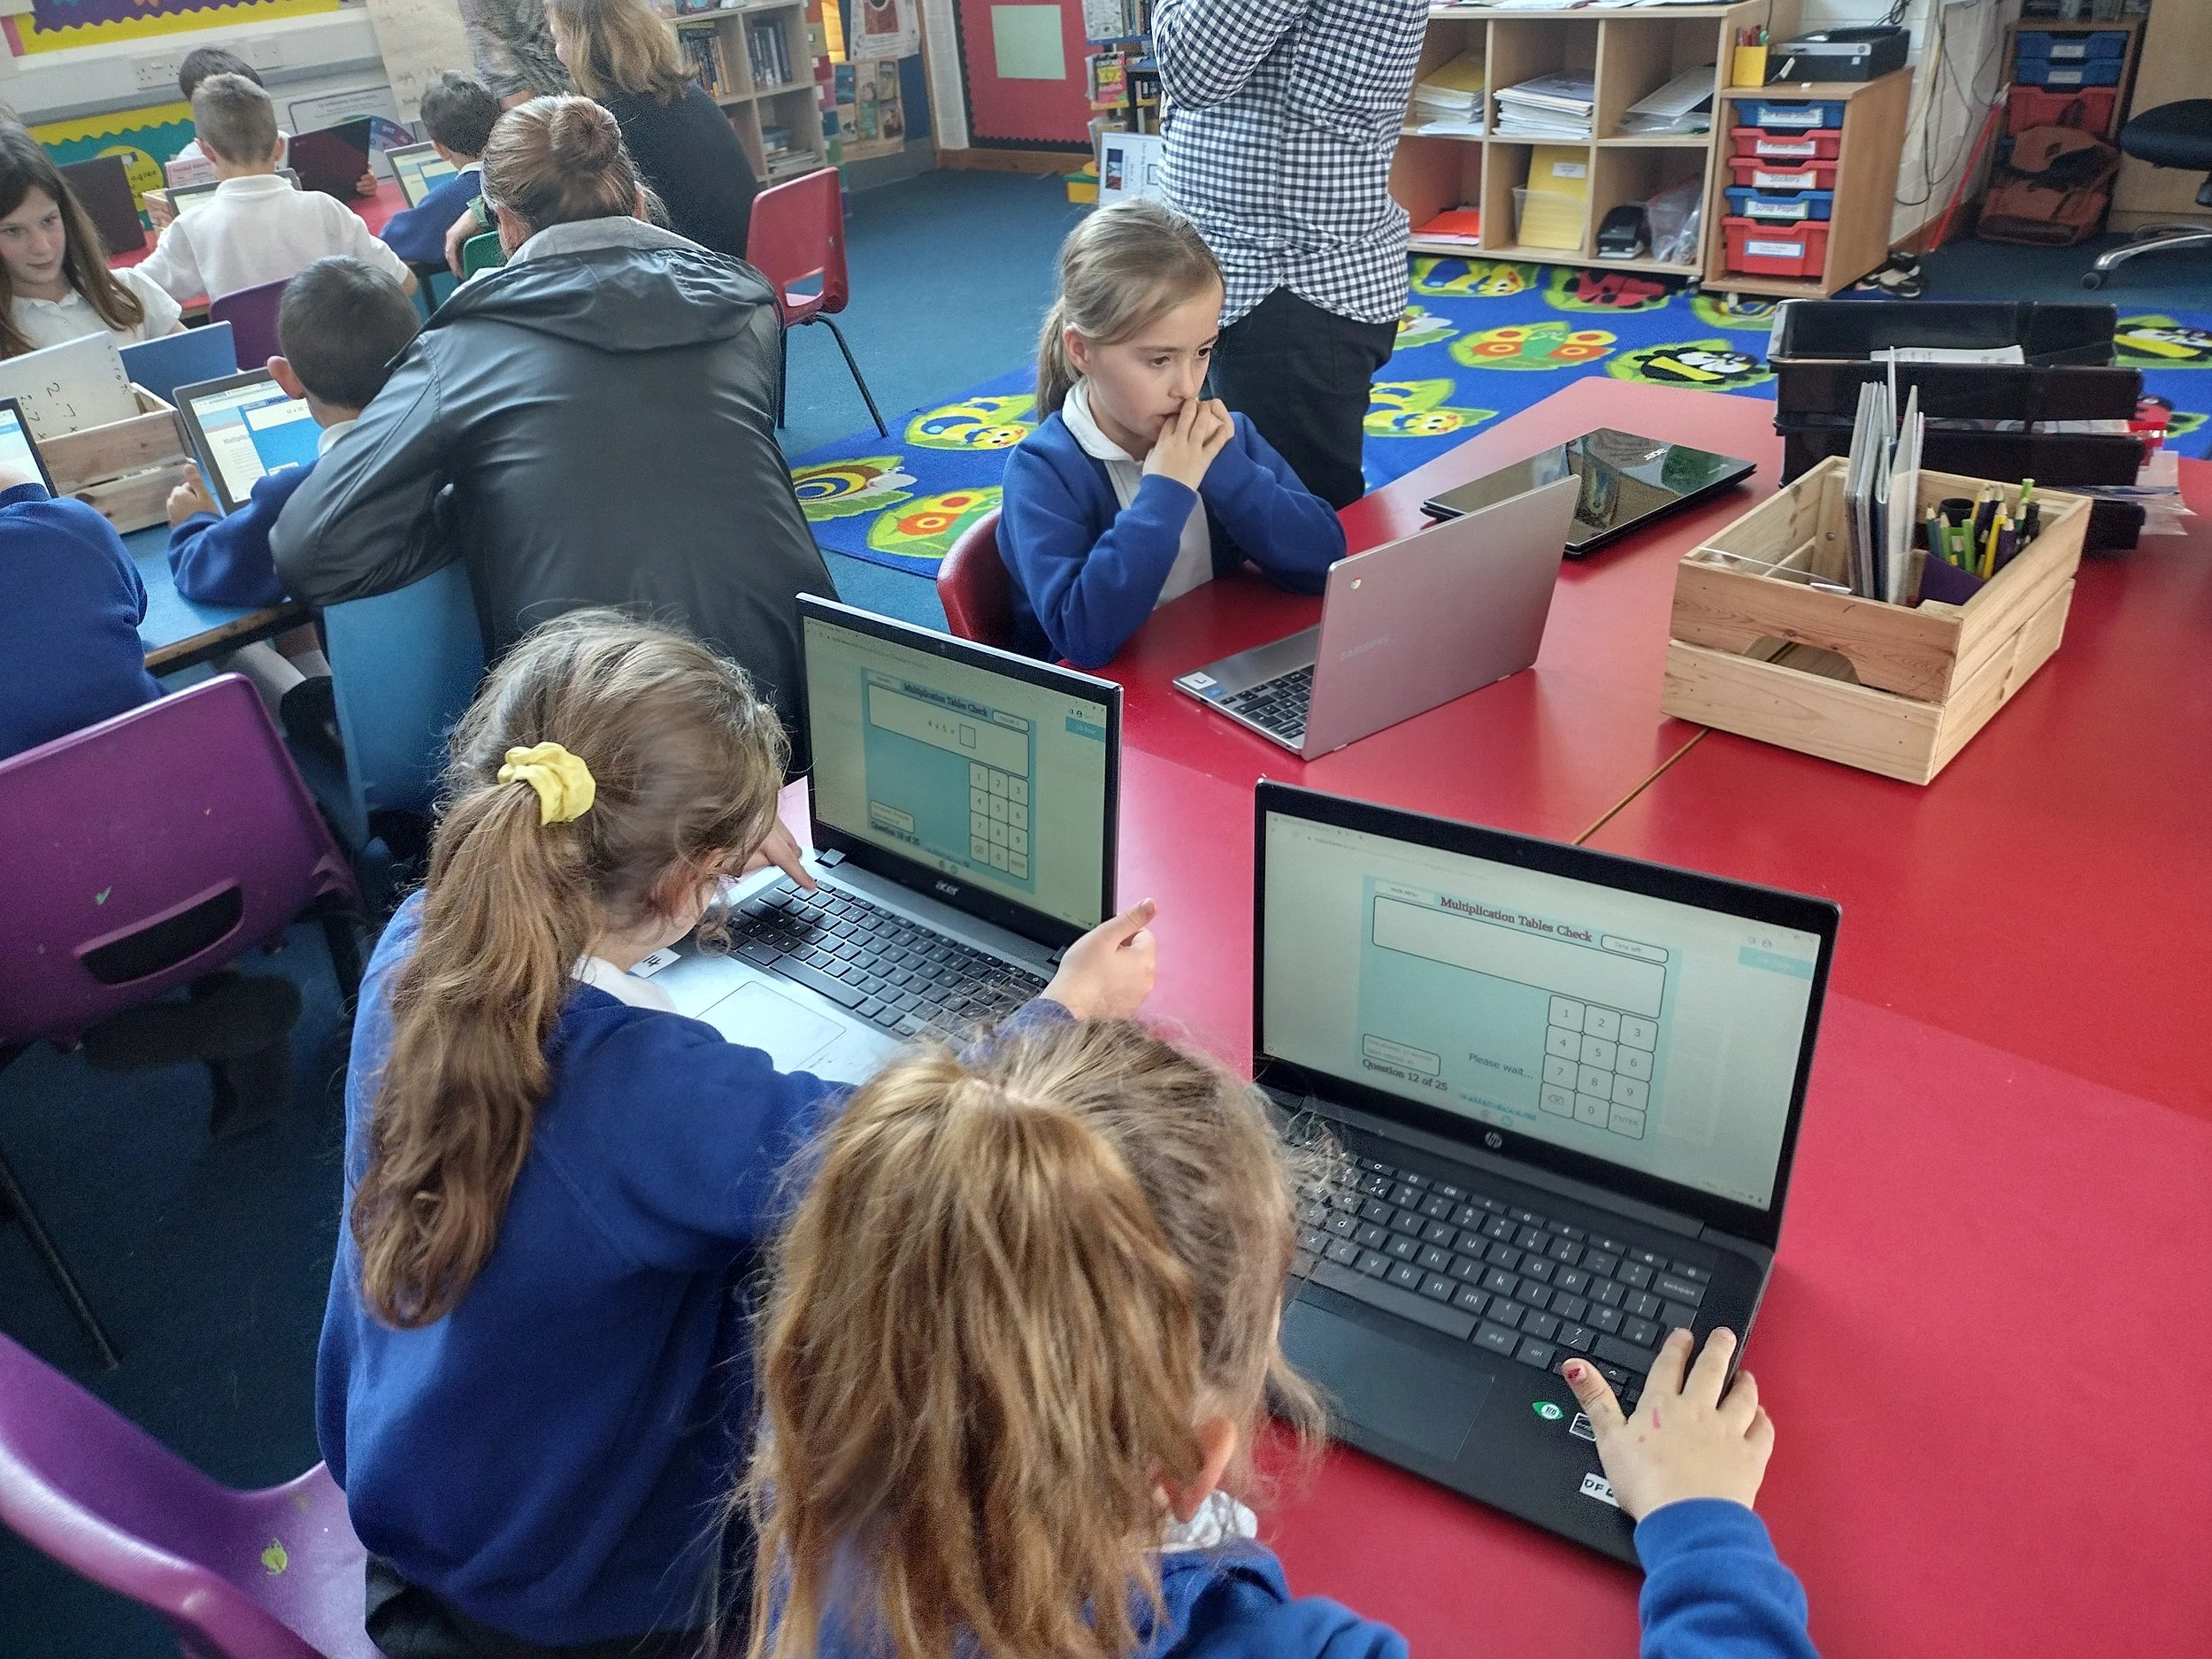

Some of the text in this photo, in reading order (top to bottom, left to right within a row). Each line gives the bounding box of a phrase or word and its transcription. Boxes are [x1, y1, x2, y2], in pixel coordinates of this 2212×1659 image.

[1770, 174, 1800, 183] Stickers
[903, 682, 988, 718] Multiplication Tables Check
[935, 879, 959, 896] acer
[1440, 896, 1593, 943] Multiplication Tables Check
[642, 954, 662, 967] 14
[1564, 1009, 1641, 1038] 1 2 3
[1469, 1052, 1534, 1079] Please wait...
[1560, 1039, 1637, 1067] 4 5 6
[1363, 1058, 1448, 1091] Question 12 of 25
[1557, 1067, 1633, 1096] 7 8 9
[1588, 1105, 1594, 1115] 0
